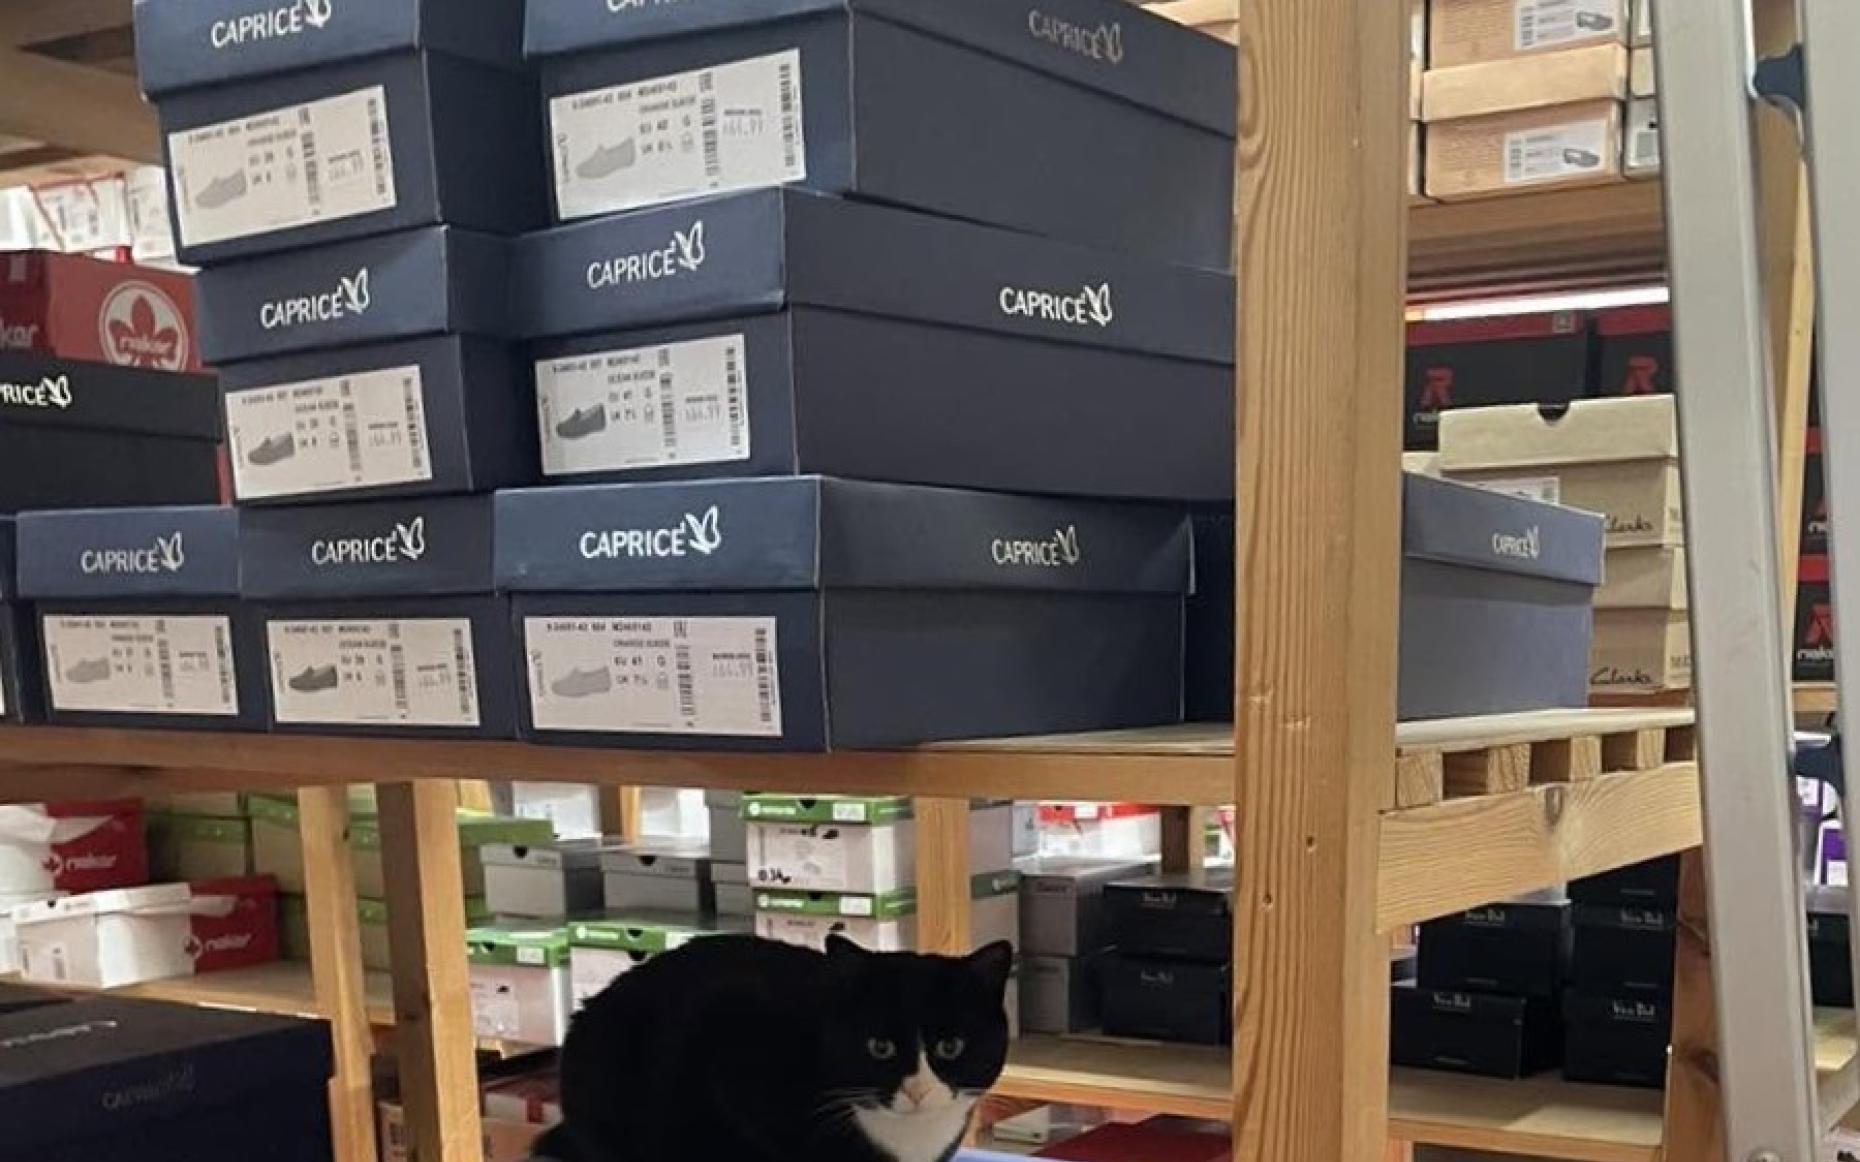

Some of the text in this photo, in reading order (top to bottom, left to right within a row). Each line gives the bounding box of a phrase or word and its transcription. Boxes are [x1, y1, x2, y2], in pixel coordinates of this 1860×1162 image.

[211, 10, 302, 48] CAPRICE
[1029, 10, 1104, 59] CAPRICE
[588, 248, 676, 288] CAPRICE
[261, 293, 343, 329] CAPRICE
[1000, 287, 1087, 323] CAPRICE
[0, 383, 49, 406] RICE
[312, 537, 398, 564] CAPRICE
[580, 528, 687, 558] CAPRICE
[992, 538, 1060, 567] CAPRICE
[82, 549, 159, 574] CAPRICE
[1591, 667, 1652, 686] Clarks
